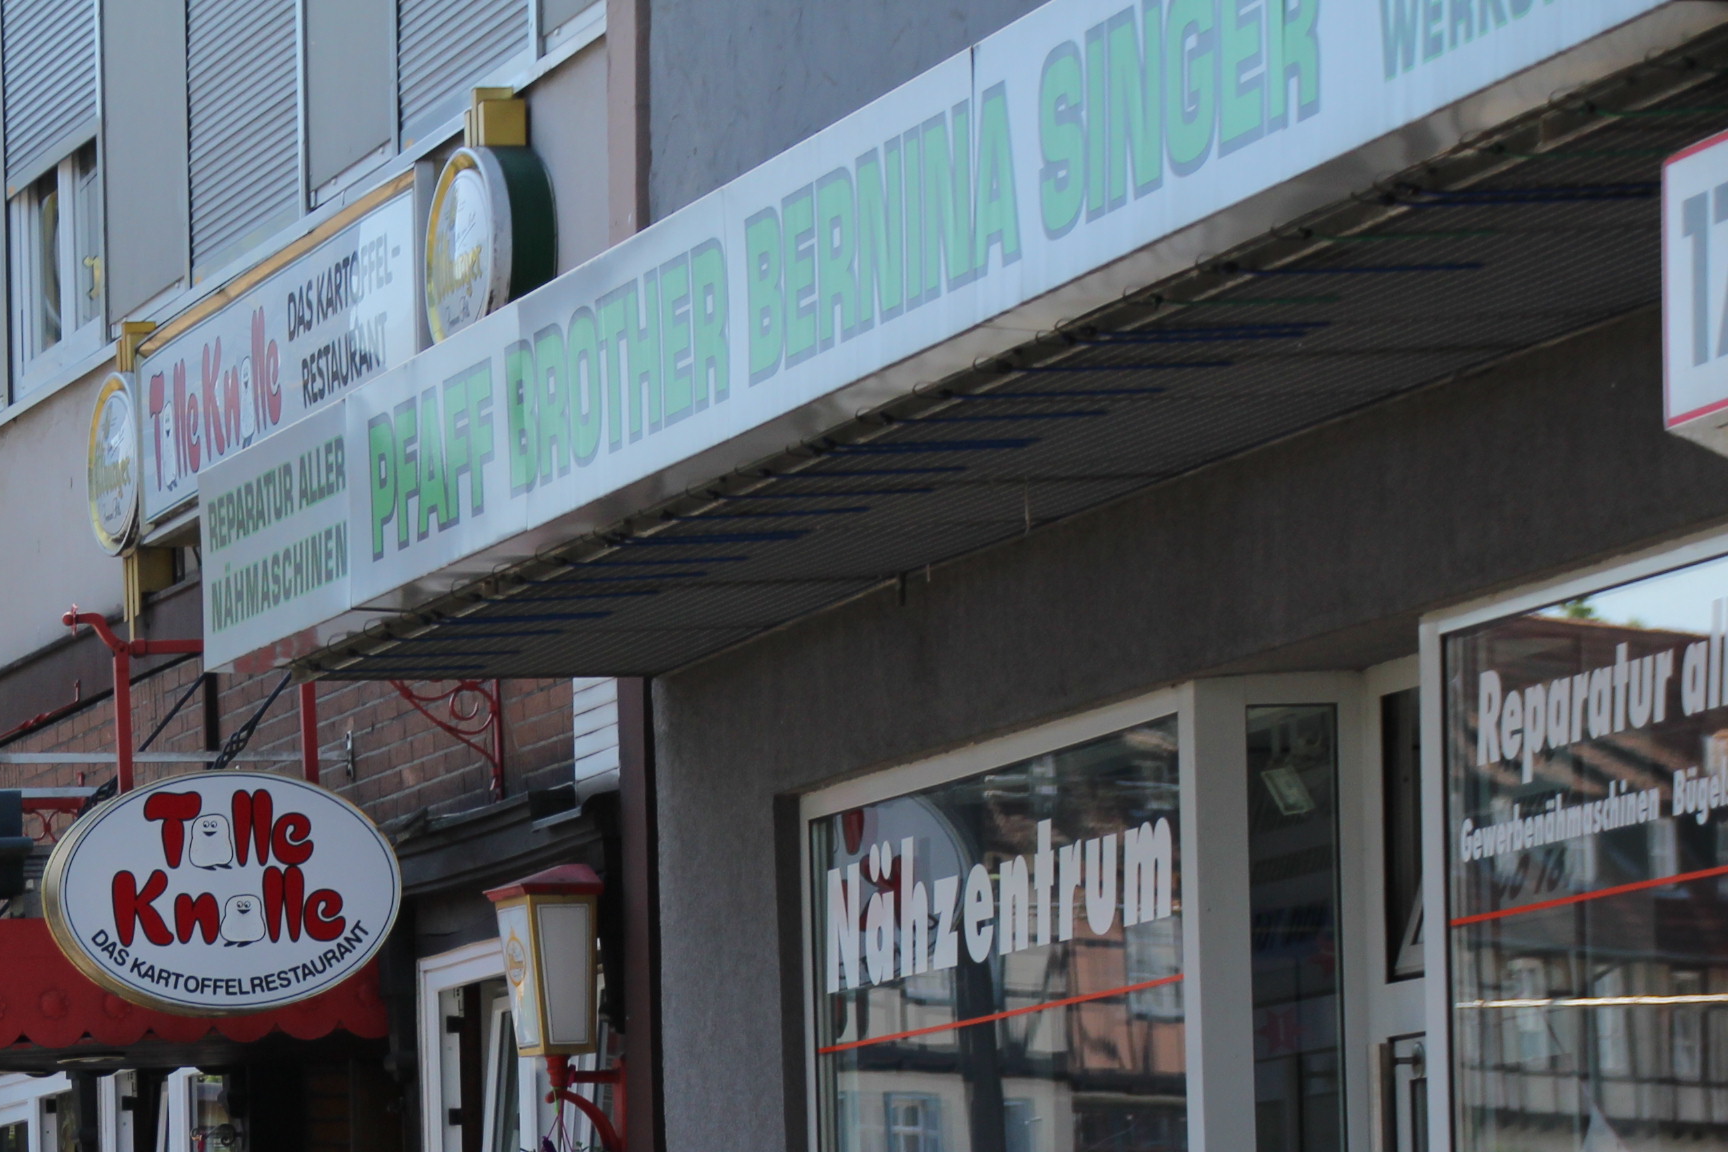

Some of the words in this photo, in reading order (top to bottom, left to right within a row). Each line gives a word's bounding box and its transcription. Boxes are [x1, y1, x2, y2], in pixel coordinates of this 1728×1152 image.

[288, 279, 314, 342] DAS
[316, 232, 401, 320] KARTOFFEL-
[368, 356, 494, 562] PFAFF
[504, 237, 730, 493] BROTHER
[744, 80, 1022, 388] BERNINA
[1038, 0, 1320, 242] SINGER
[301, 311, 388, 409] RESTAURANT
[207, 461, 295, 553] REPARATUR
[298, 434, 347, 511] ALLER
[211, 519, 348, 635] NÄHMASCHINEN
[1476, 642, 1674, 785] Reparatur
[1460, 779, 1661, 863] Gewerbenähmaschinen
[91, 928, 130, 967] DAS
[129, 919, 371, 996] KARTOFFELRESTAURANT
[826, 816, 1172, 995] Nähzentrum
